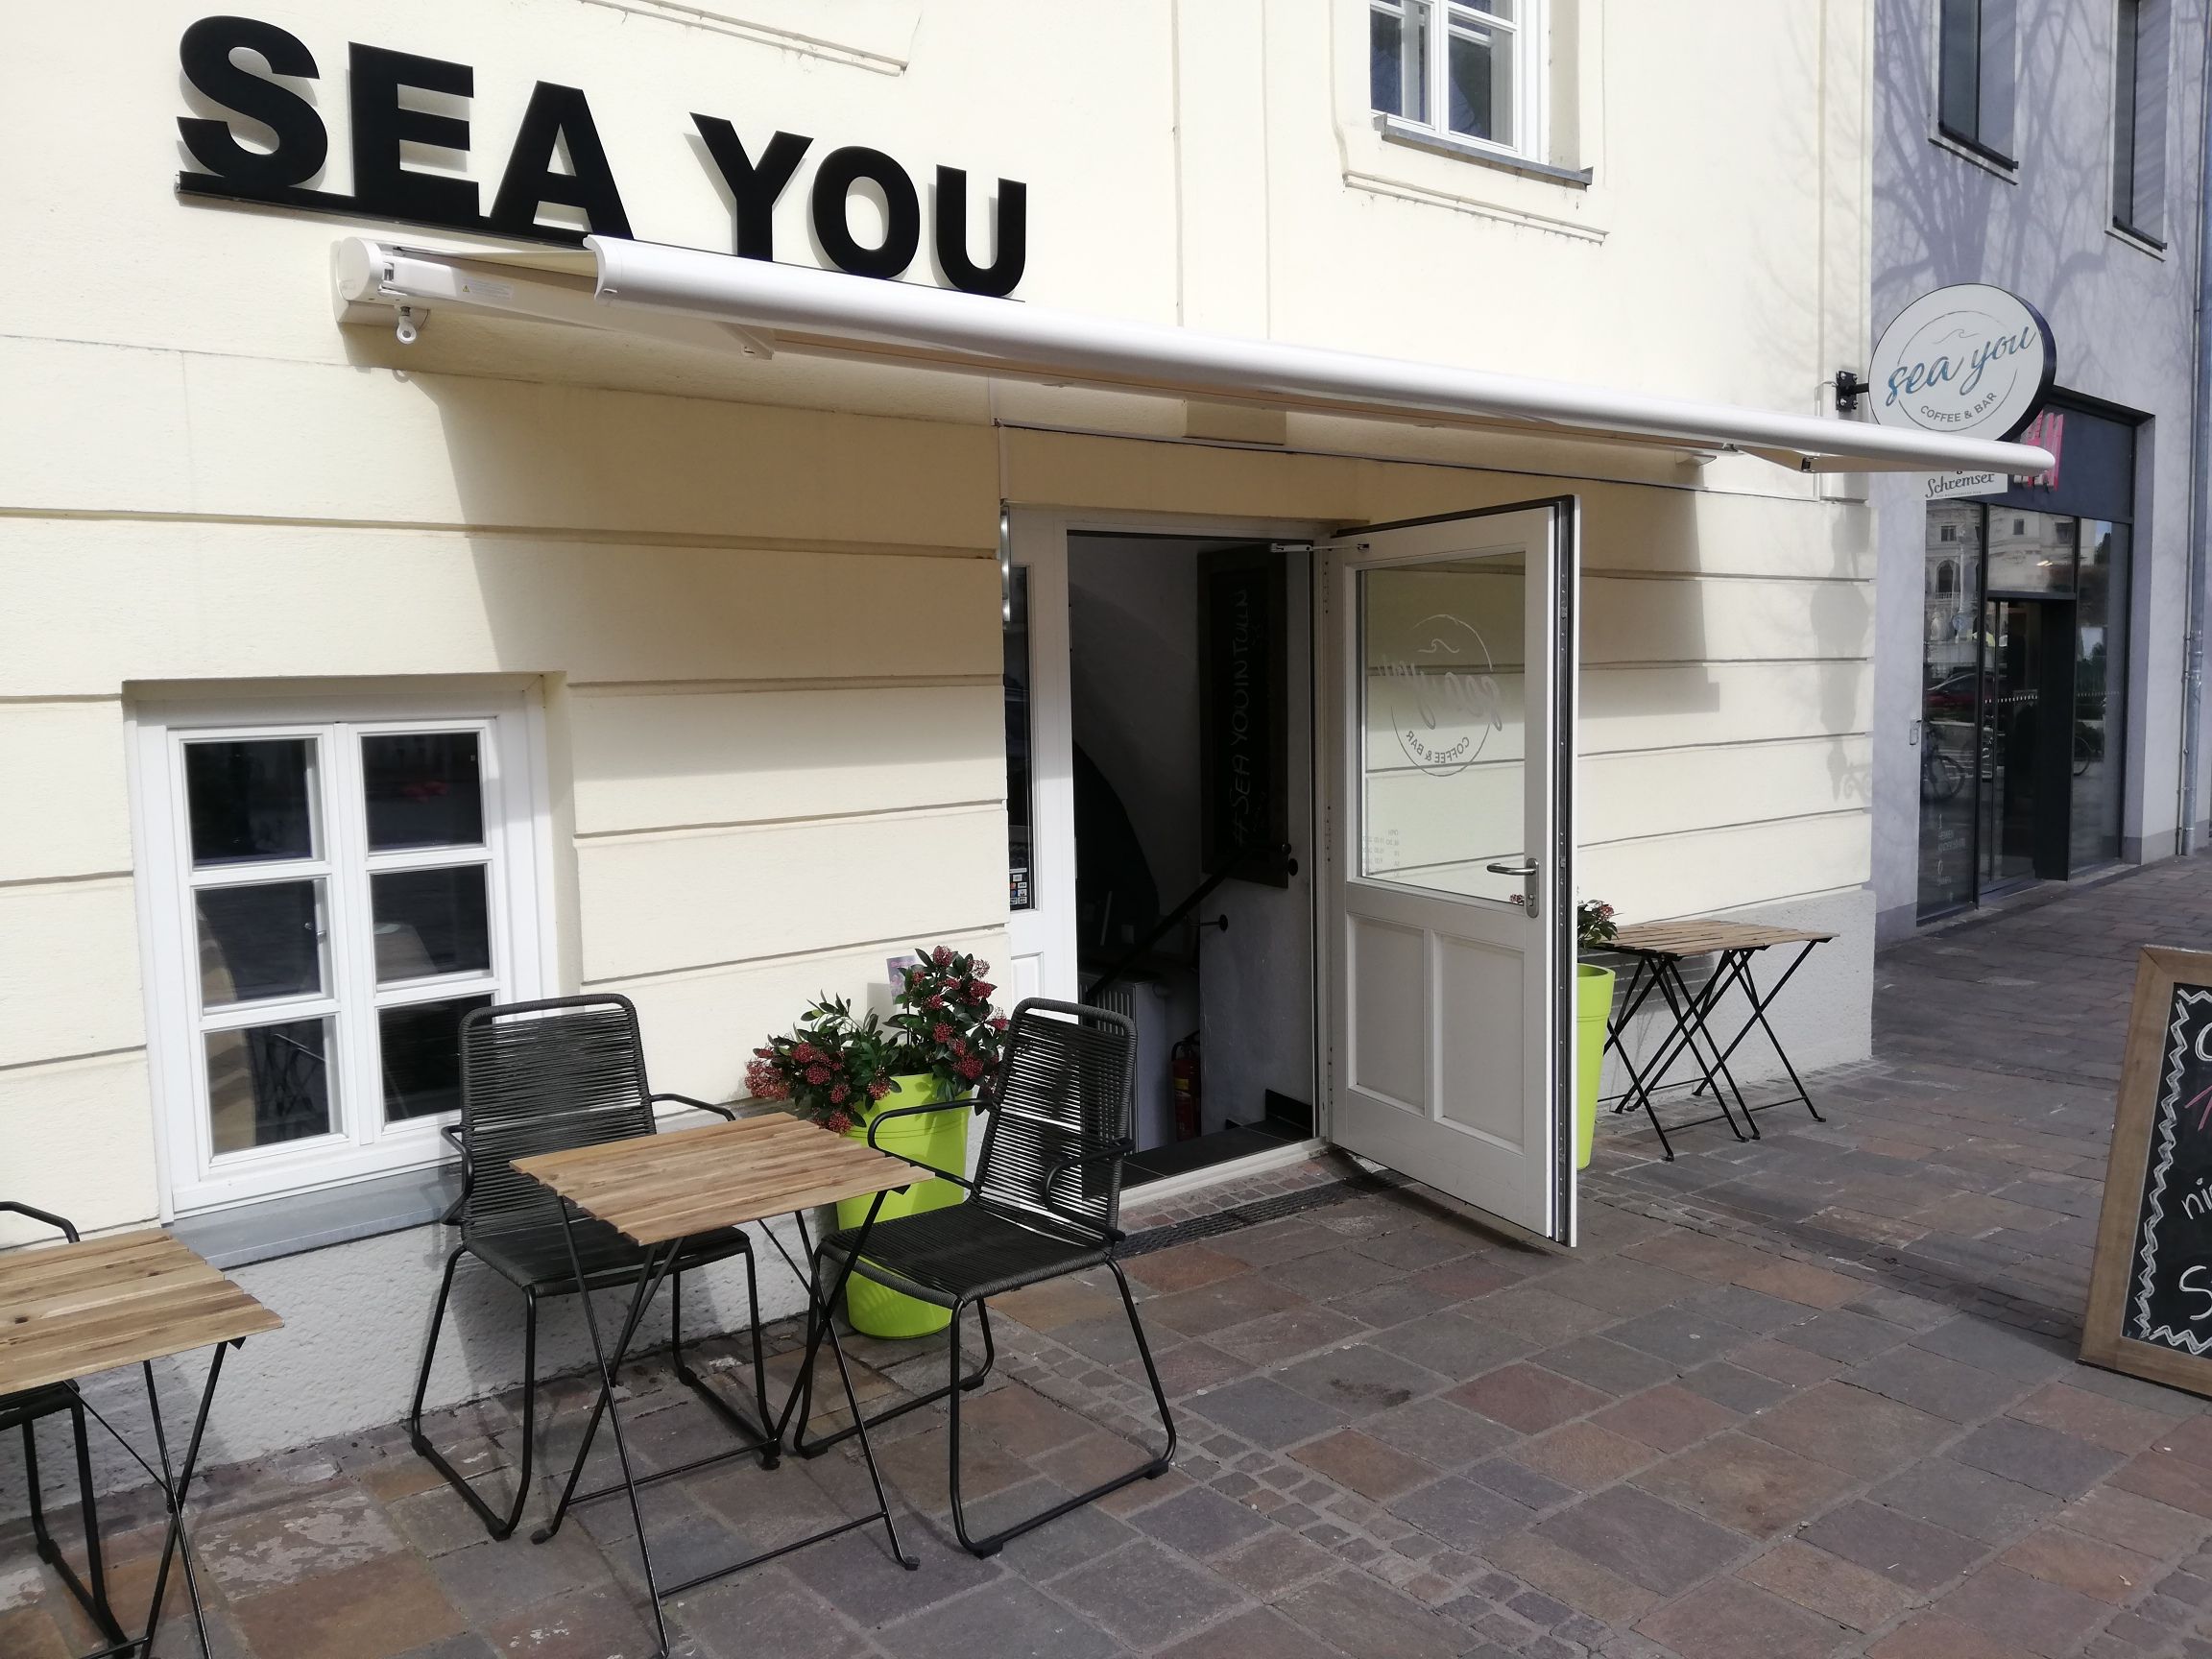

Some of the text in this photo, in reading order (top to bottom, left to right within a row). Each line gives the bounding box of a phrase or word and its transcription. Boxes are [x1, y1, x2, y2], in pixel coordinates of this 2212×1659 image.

[177, 15, 1027, 298] SEA YOU
[1886, 326, 2036, 406] sea you
[1920, 392, 1997, 422] COFFEE & BAR
[1925, 473, 1995, 498] Schremser
